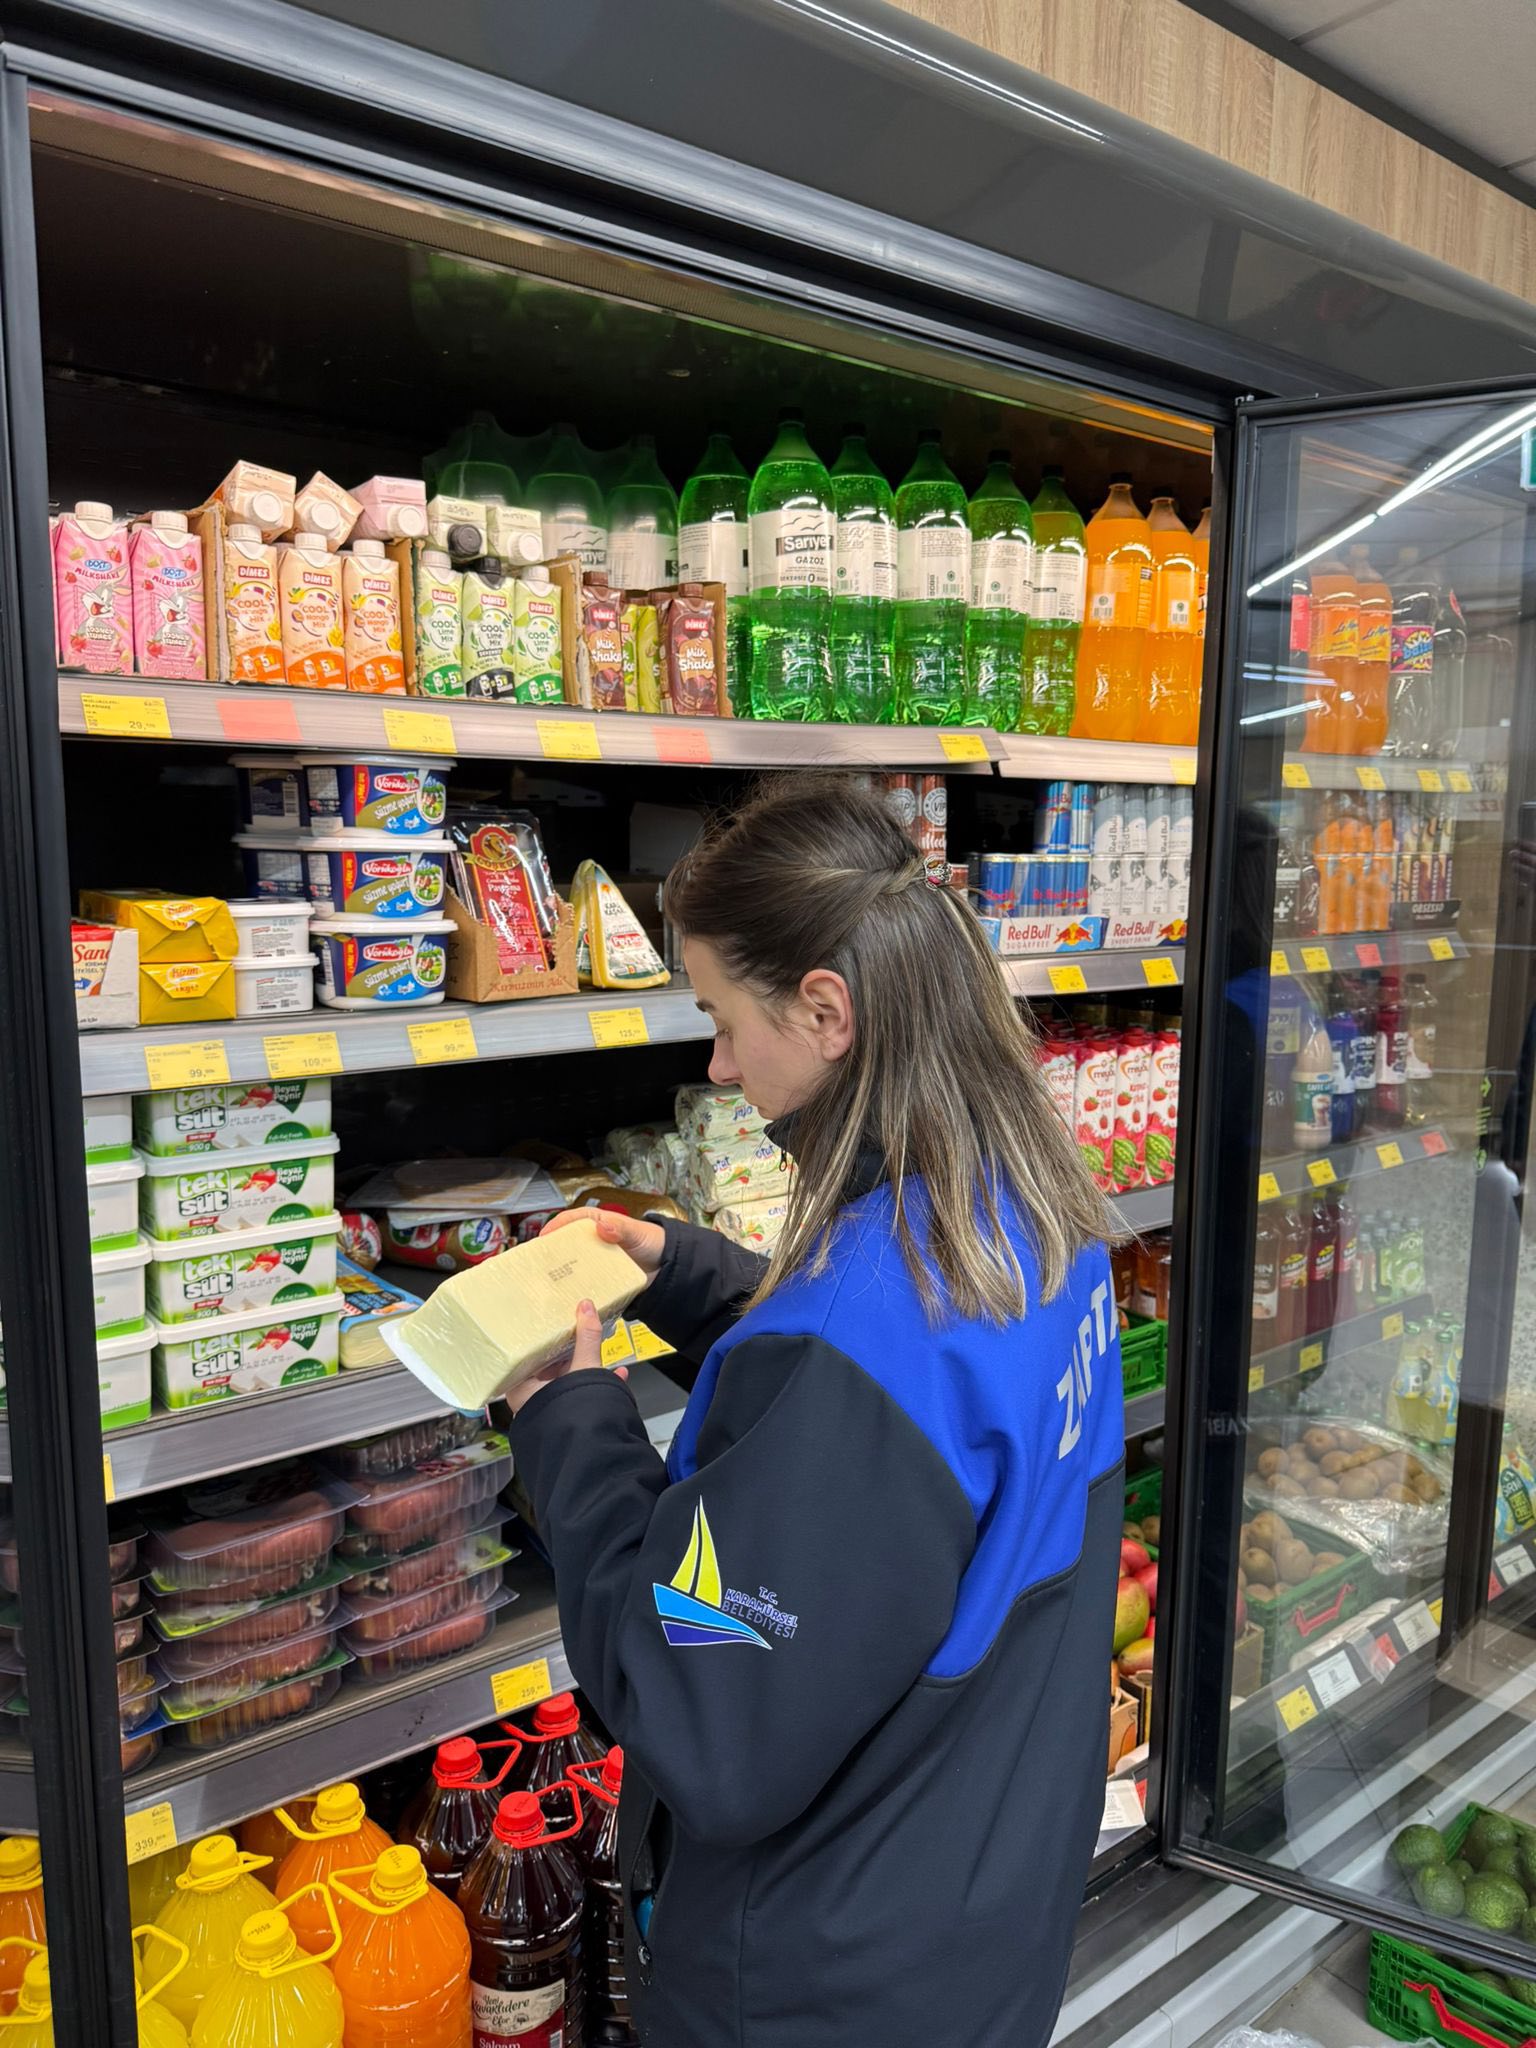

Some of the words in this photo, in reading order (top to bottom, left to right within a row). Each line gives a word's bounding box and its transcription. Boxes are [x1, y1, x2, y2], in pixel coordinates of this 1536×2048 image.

[795, 556, 825, 565] GAZOZ
[238, 599, 268, 609] COOL
[302, 605, 329, 614] COOL
[363, 610, 388, 619] COOL
[431, 620, 455, 629] COOL
[480, 624, 504, 633] COOL
[438, 628, 454, 636] Lime
[527, 631, 552, 640] COOL
[596, 640, 615, 649] Milk
[686, 647, 707, 659] Milk
[678, 659, 715, 671] Shake
[1008, 924, 1029, 940] Red
[1030, 924, 1051, 939] Bull
[1114, 922, 1134, 937] Red
[1134, 921, 1154, 935] Bull
[177, 1106, 225, 1131] süt
[179, 1172, 227, 1199] tek
[179, 1193, 230, 1216] süt
[182, 1254, 231, 1282] tek
[184, 1273, 234, 1299] süt
[193, 1334, 240, 1360] tek
[193, 1350, 242, 1377] süt
[759, 1586, 779, 1606] T.C.
[724, 1588, 799, 1629] KARAMÜRSEL
